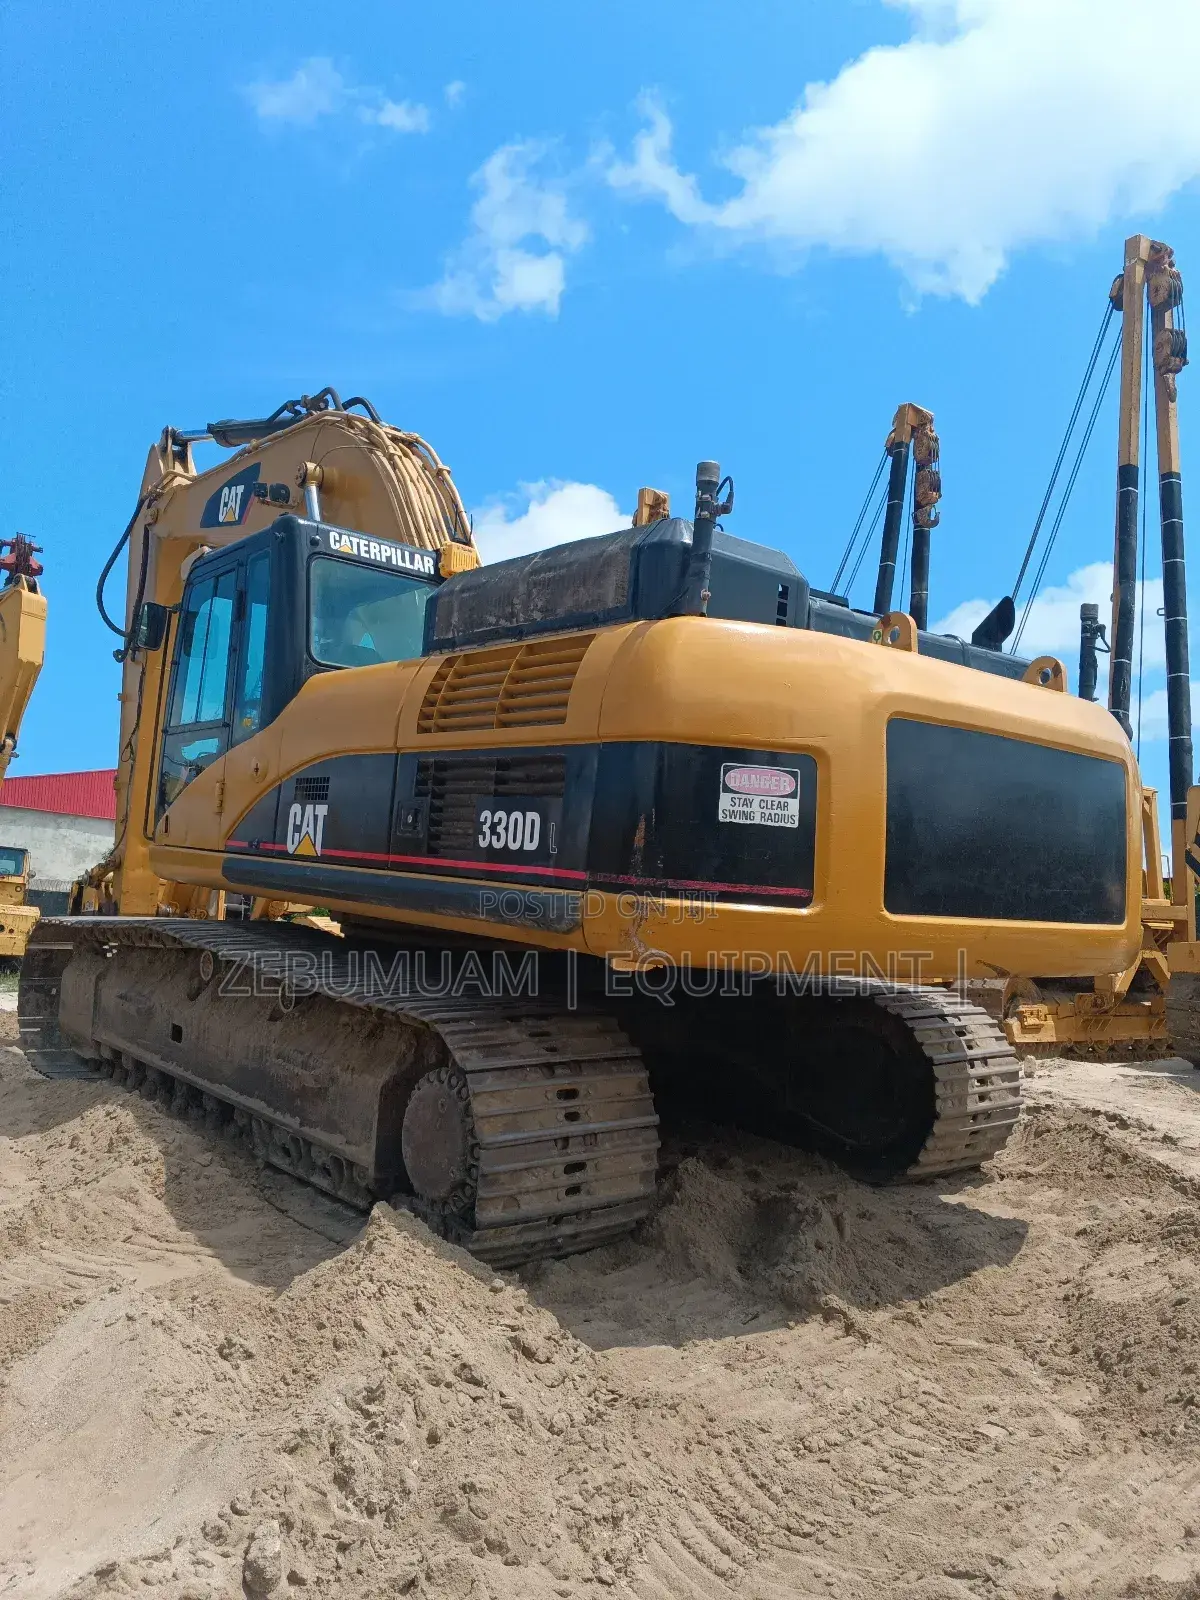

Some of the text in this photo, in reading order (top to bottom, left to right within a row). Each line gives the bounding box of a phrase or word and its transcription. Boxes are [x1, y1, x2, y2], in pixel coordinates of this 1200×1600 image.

[219, 485, 244, 522] CAT
[329, 531, 435, 575] CATERPILLAR
[730, 773, 790, 791] DANGER
[721, 808, 796, 825] SWING RADIUS
[730, 796, 789, 812] STAY CLEAR
[286, 803, 329, 857] CAT
[478, 809, 541, 851] 330D
